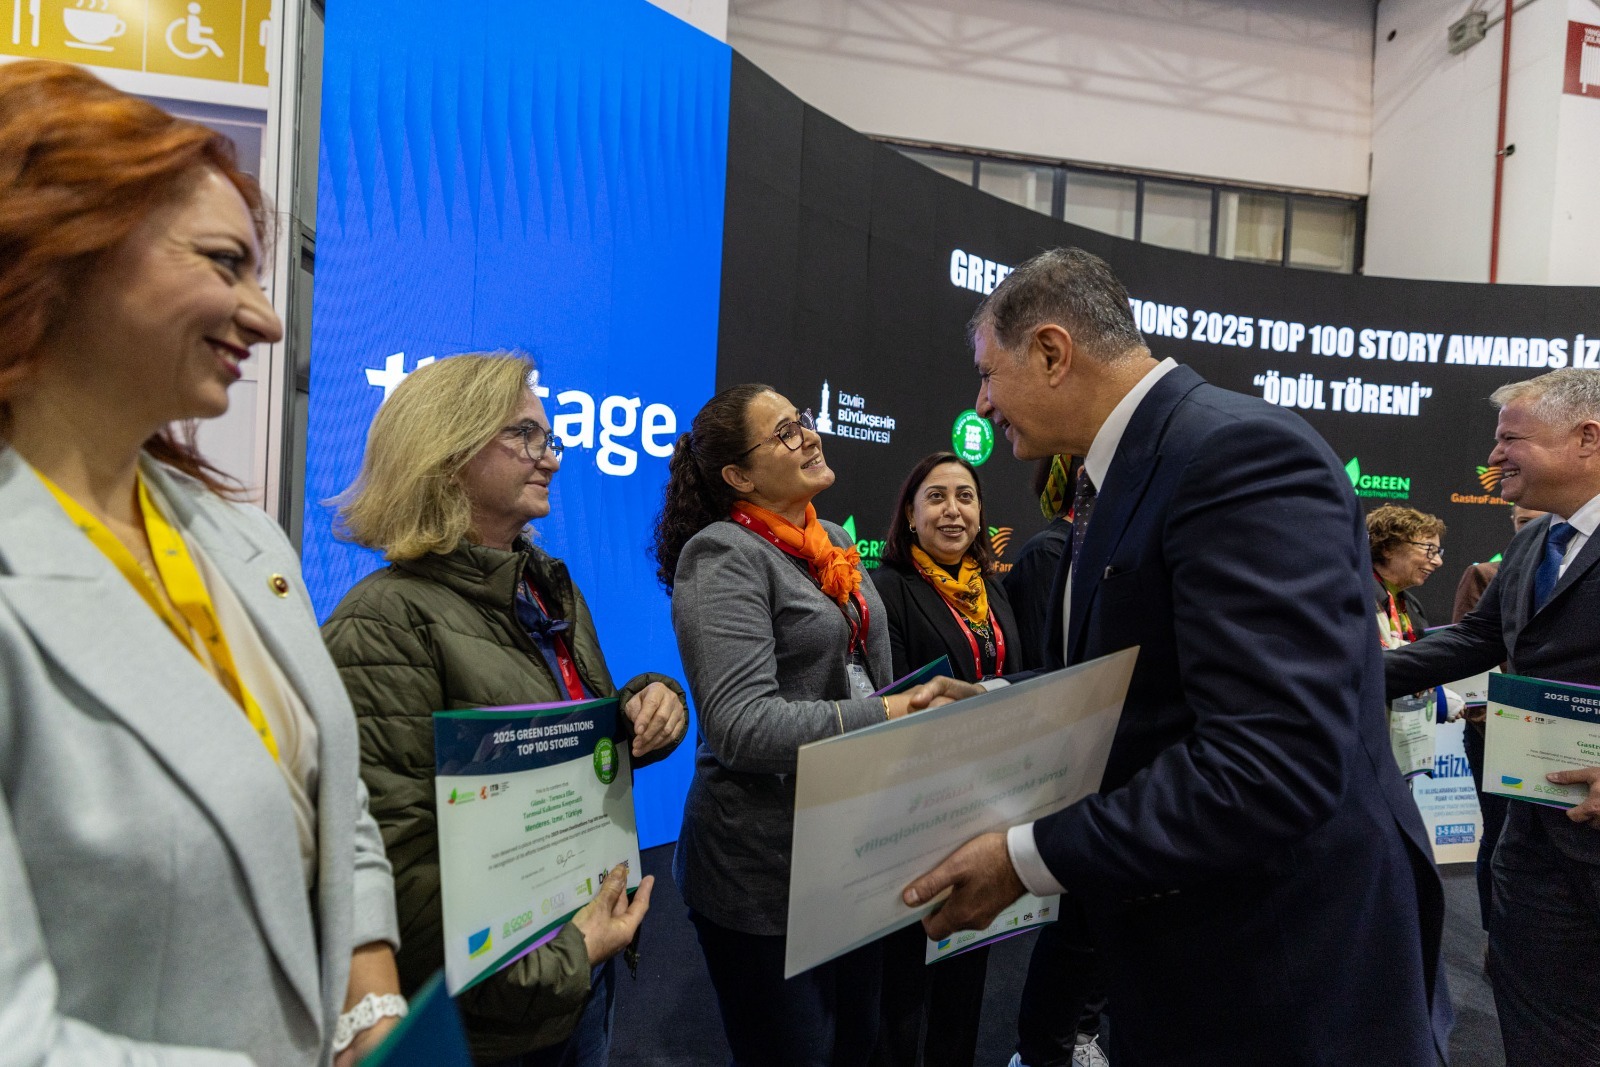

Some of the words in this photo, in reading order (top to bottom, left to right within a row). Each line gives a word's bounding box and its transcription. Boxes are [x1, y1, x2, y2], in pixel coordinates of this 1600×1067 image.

[950, 249, 1016, 296] GREE
[1191, 310, 1254, 347] 2025
[1258, 319, 1305, 352] TOP
[1308, 324, 1355, 357] 100
[1359, 328, 1444, 363] STORY
[1445, 334, 1568, 368] AWARDS
[838, 390, 865, 410] İZMİR
[838, 408, 896, 431] BÜYÜKŞEHİR
[837, 424, 891, 444] BELEDİYESİ
[1359, 475, 1410, 491] GREEN
[1359, 490, 1409, 500] DESTINATIONS
[1544, 692, 1570, 702] 2025
[1571, 704, 1592, 713] TOP
[493, 730, 516, 745] 2025
[516, 729, 543, 740] GREEN
[544, 720, 594, 736] DESTINATIONS
[517, 744, 536, 756] TOP
[535, 740, 549, 753] 100
[549, 736, 579, 750] STORIES
[1436, 826, 1449, 836] 3-5
[1450, 824, 1475, 835] ARALIK
